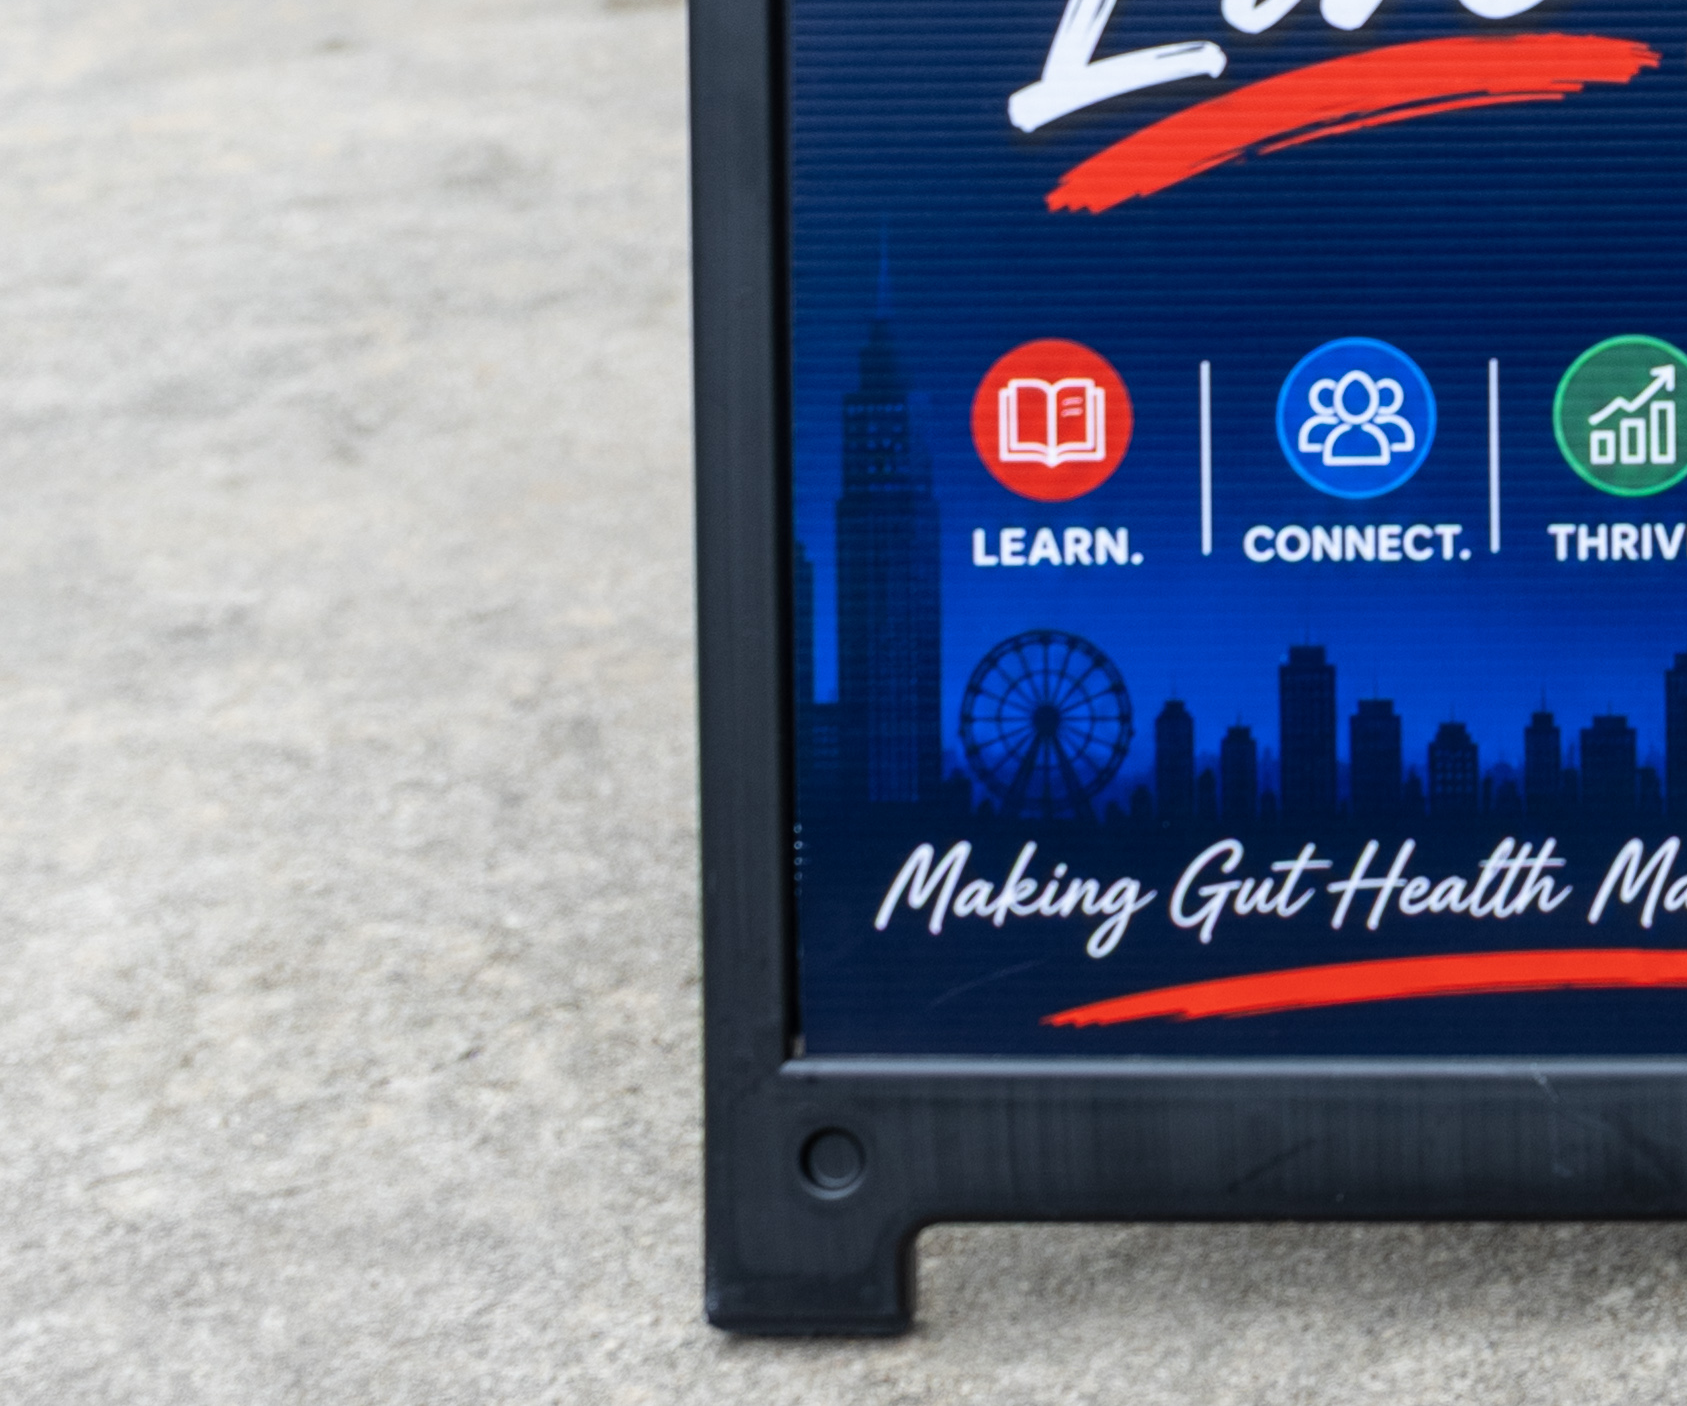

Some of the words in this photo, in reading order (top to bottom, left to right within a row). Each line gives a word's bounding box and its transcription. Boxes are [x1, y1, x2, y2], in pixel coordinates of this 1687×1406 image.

[972, 527, 1144, 568] LEARN.
[1243, 524, 1472, 563] CONNECT.
[874, 839, 1156, 958] Making
[1170, 836, 1333, 944] Gut
[1327, 836, 1573, 930] Health
